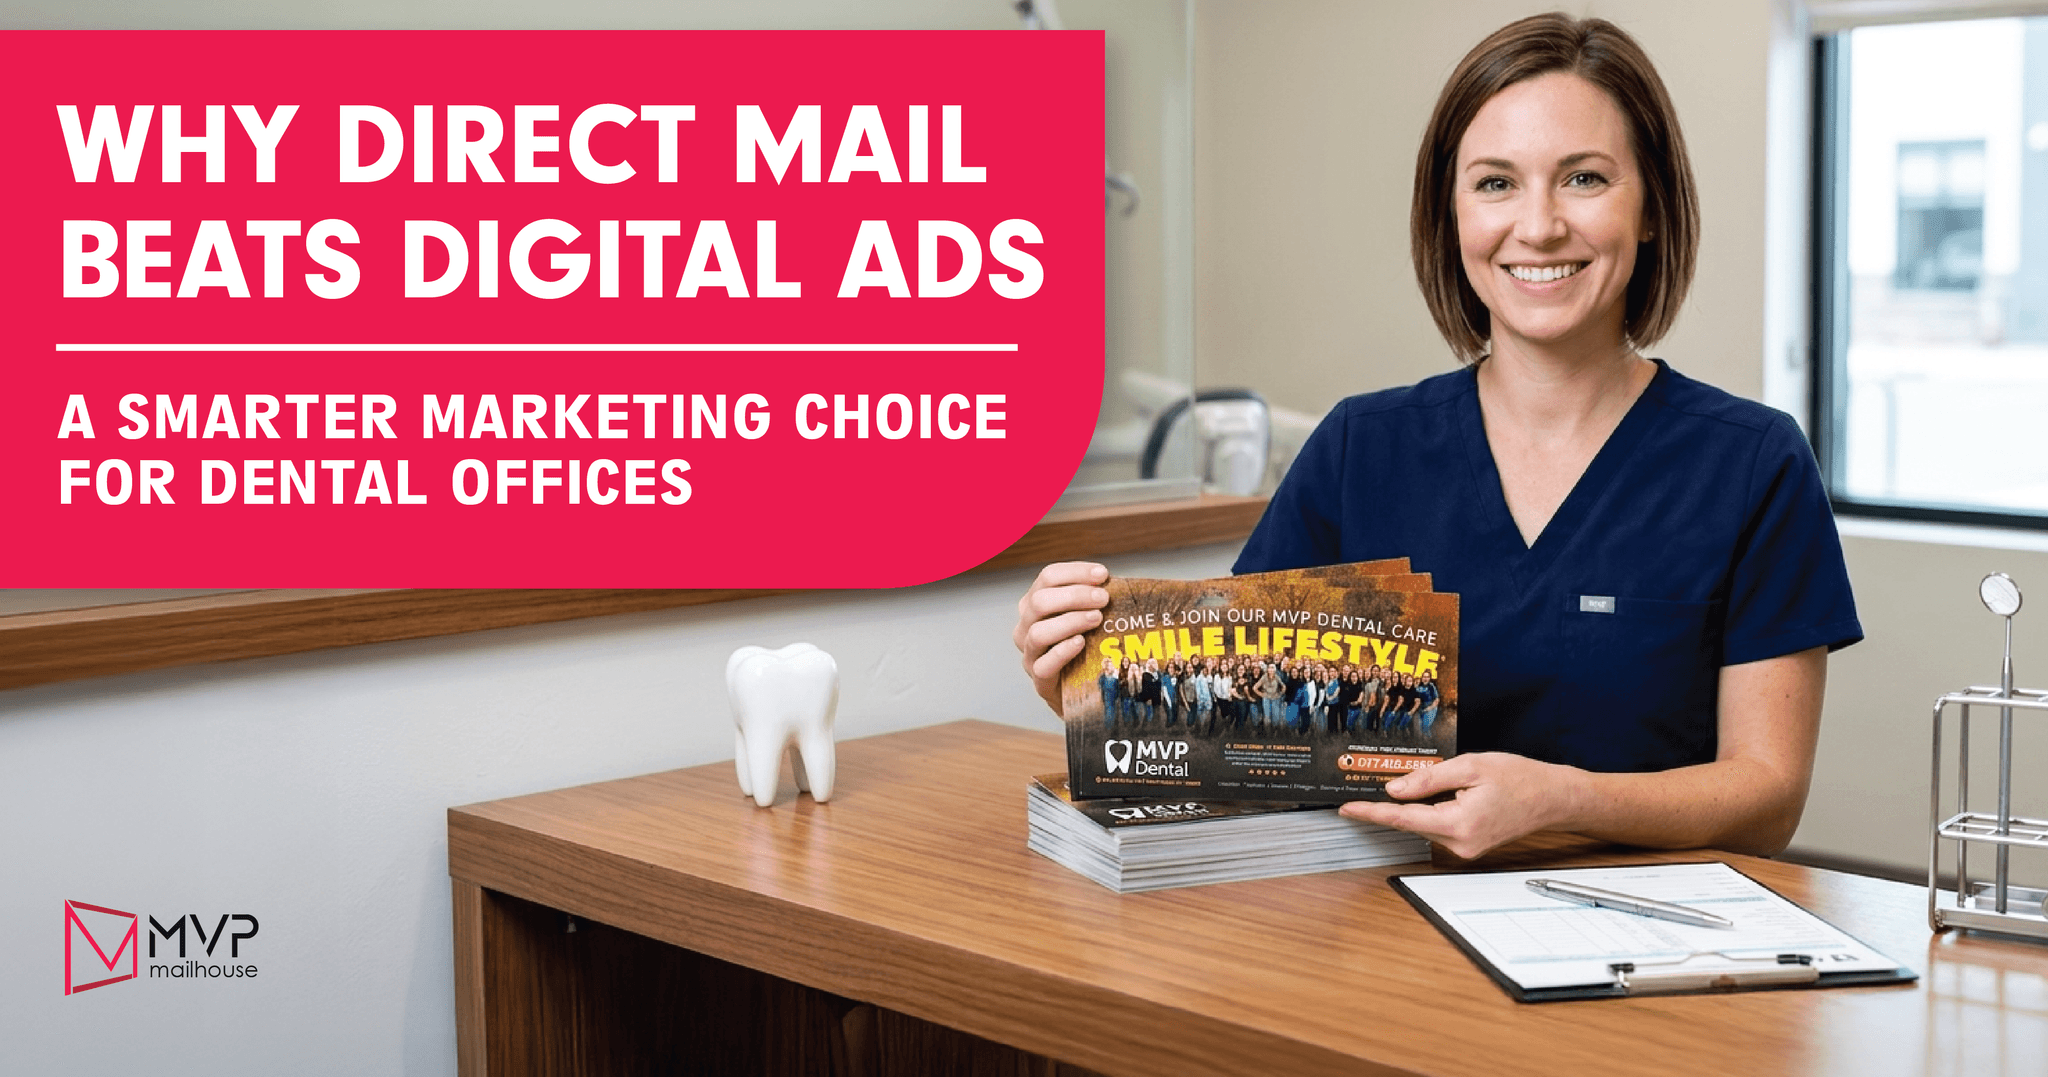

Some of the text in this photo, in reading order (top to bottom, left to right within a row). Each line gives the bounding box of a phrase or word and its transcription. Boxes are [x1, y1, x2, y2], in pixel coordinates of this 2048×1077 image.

[1103, 613, 1156, 633] COME
[1180, 610, 1220, 625] JOIN
[1227, 608, 1266, 623] OUR
[1272, 609, 1311, 625] MVP
[1317, 611, 1386, 636] DENTAL
[1391, 624, 1438, 647] CARE
[1099, 626, 1441, 680] SMILE LIFESTYLE
[1136, 740, 1190, 760] MVP
[1135, 760, 1190, 777] Dental
